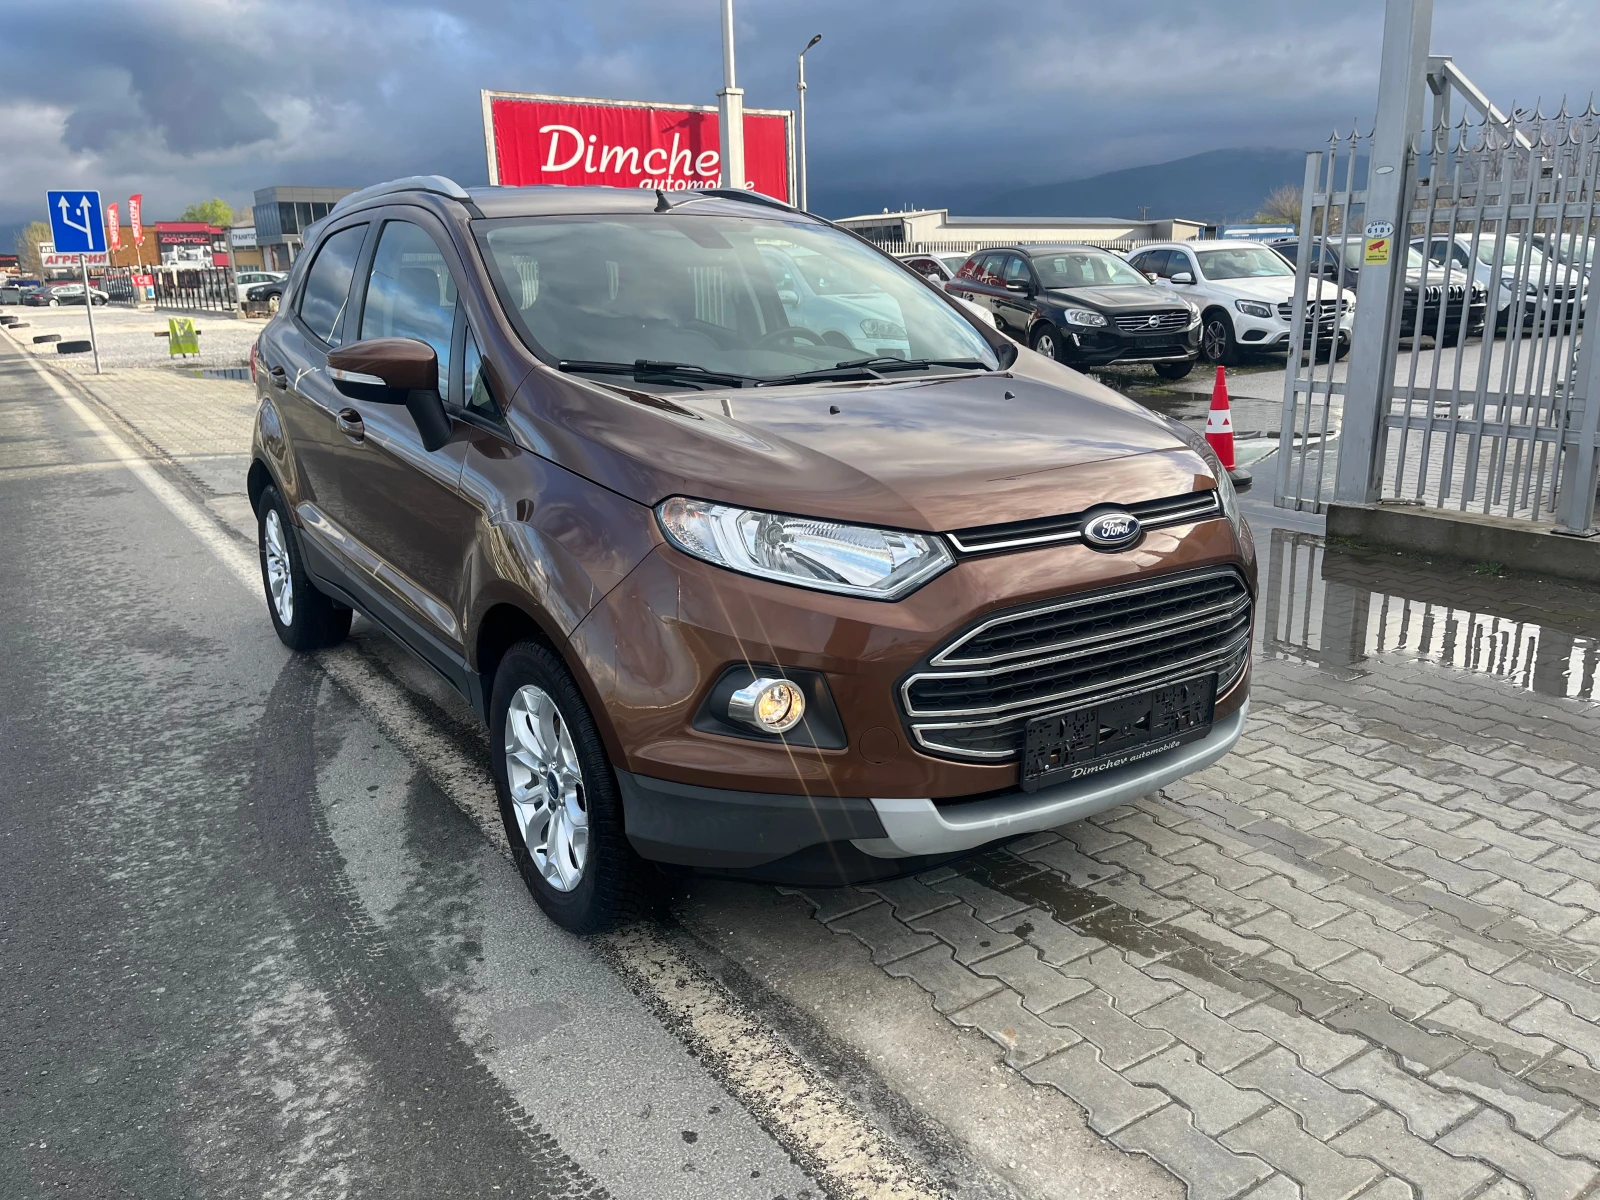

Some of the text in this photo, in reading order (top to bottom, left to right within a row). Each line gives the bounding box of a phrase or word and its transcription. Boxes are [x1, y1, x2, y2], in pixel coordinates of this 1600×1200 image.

[539, 124, 719, 176] Dimche
[639, 174, 755, 192] automoe
[1101, 519, 1130, 537] Ford
[1071, 740, 1181, 778] Dimchev automobile
